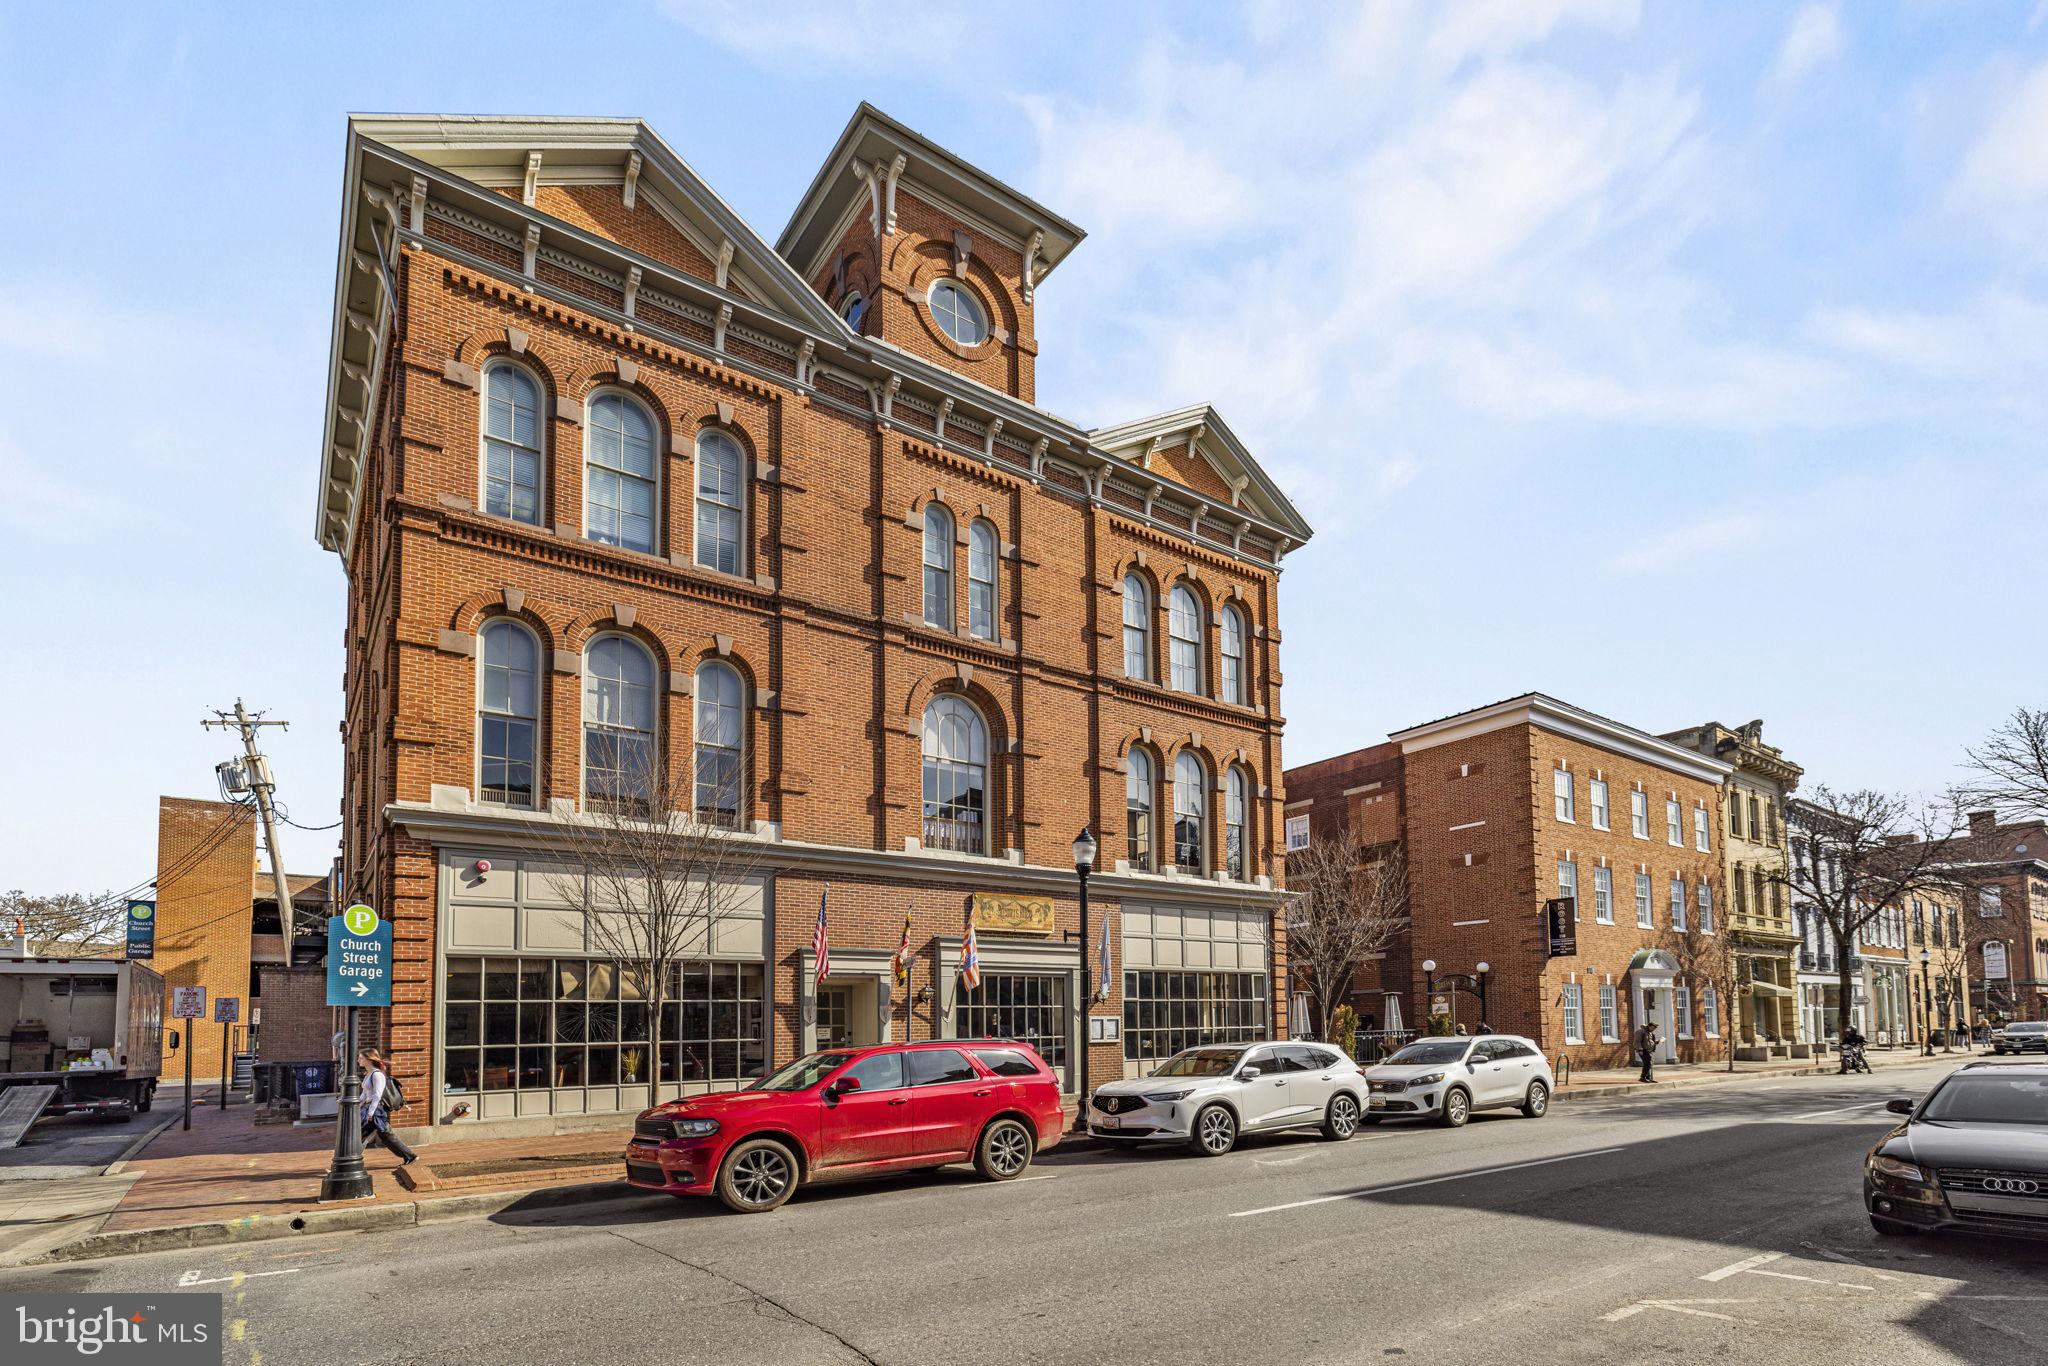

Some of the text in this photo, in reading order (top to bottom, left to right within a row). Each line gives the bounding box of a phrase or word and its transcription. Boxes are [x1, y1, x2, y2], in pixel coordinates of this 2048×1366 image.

[353, 911, 371, 929] P
[340, 938, 382, 951] Church
[342, 952, 379, 964] Street
[339, 965, 383, 980] Garage
